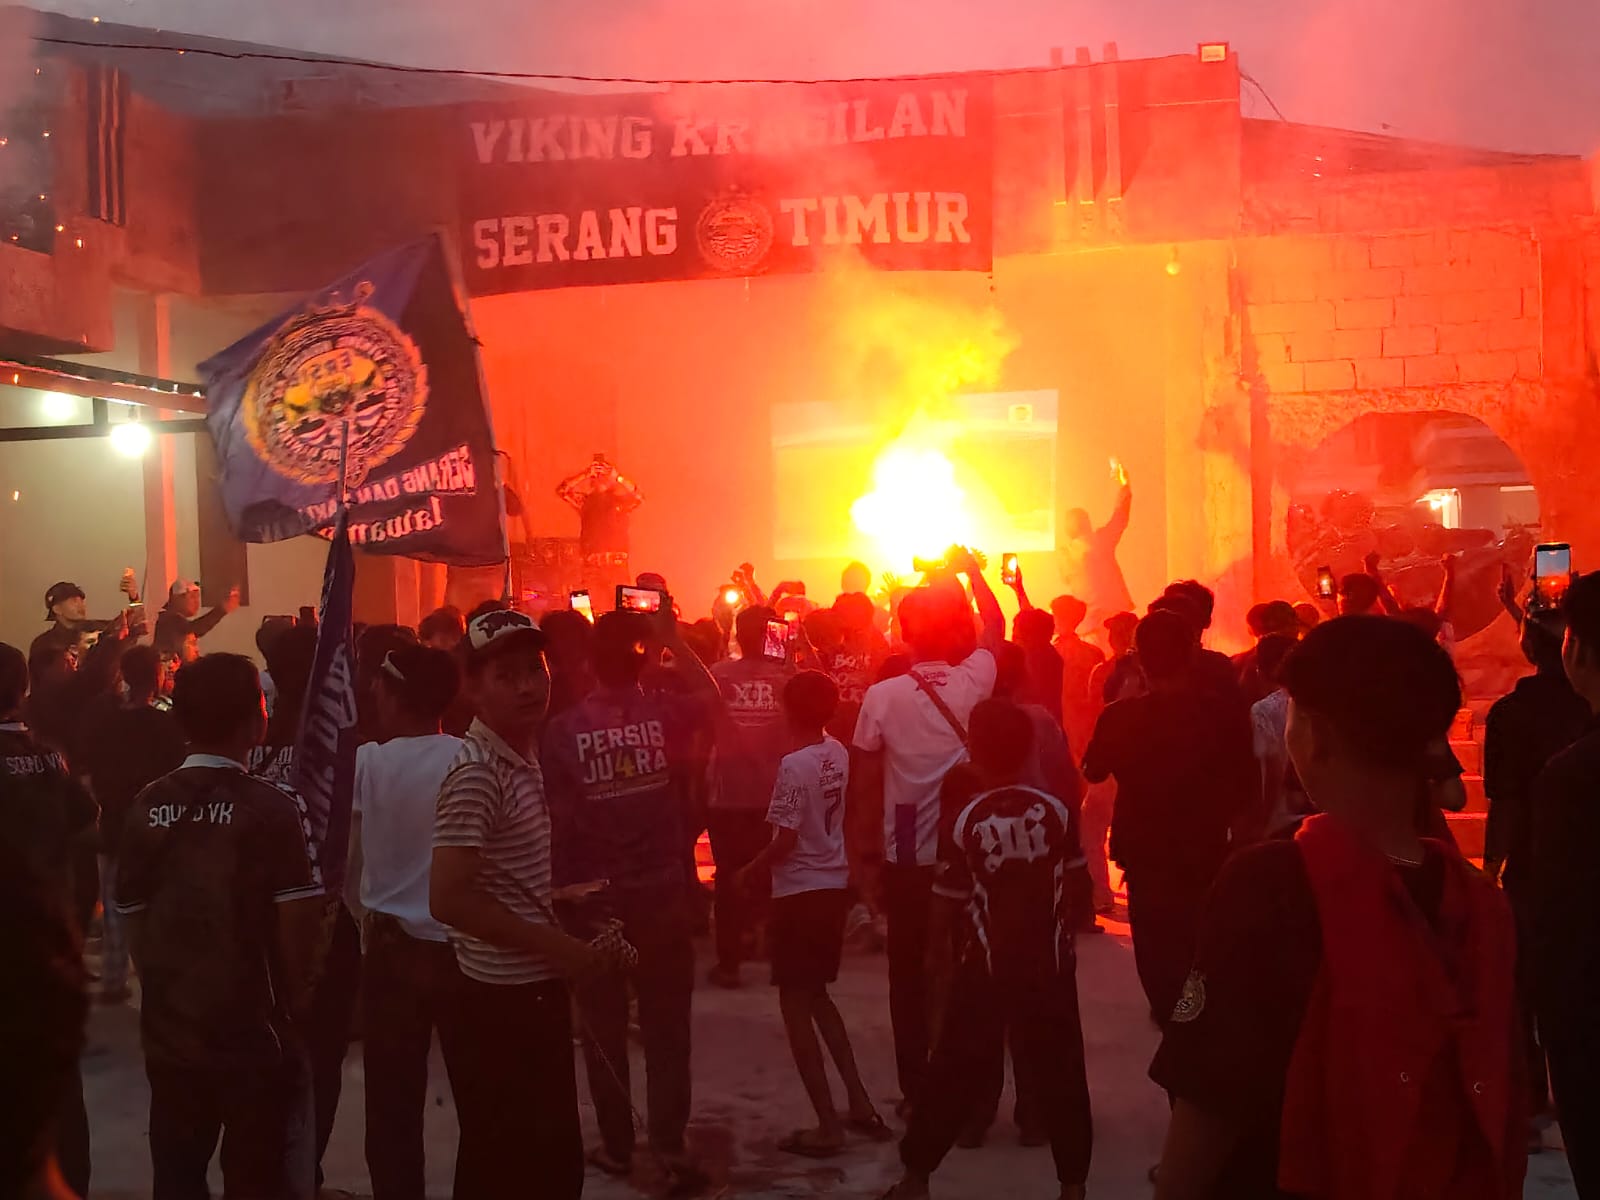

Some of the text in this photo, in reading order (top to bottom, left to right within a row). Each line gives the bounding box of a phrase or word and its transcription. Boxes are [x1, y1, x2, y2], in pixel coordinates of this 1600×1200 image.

[470, 114, 654, 164] VIKING
[473, 191, 972, 269] SERANG TIMUR
[576, 720, 666, 762] PERSIB
[583, 748, 669, 784] JU4RA
[208, 801, 234, 824] VK
[824, 786, 842, 836] 7
